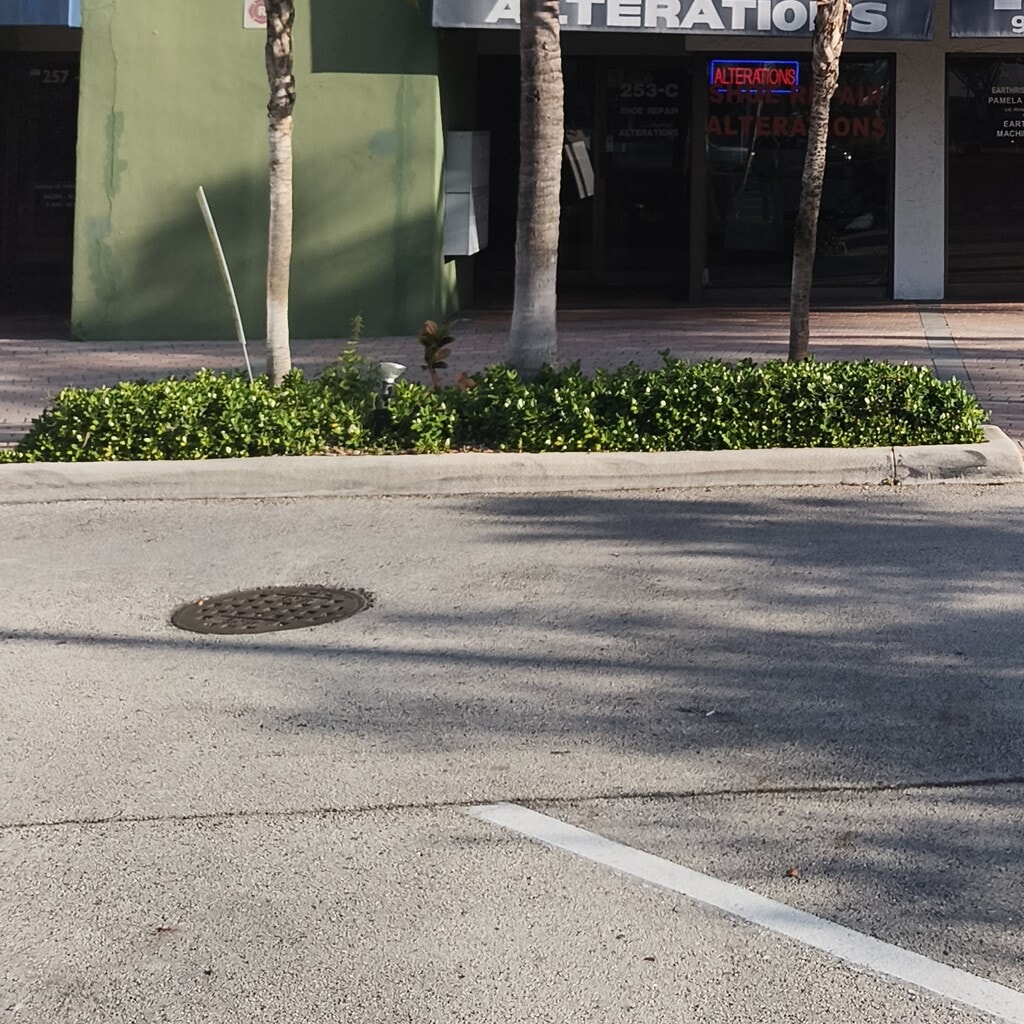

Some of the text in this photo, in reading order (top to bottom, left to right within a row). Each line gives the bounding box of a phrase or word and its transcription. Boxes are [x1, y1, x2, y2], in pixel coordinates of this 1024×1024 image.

[714, 67, 797, 86] ALTERATIONS
[620, 82, 680, 98] 253-C
[987, 96, 1023, 105] PAMELA
